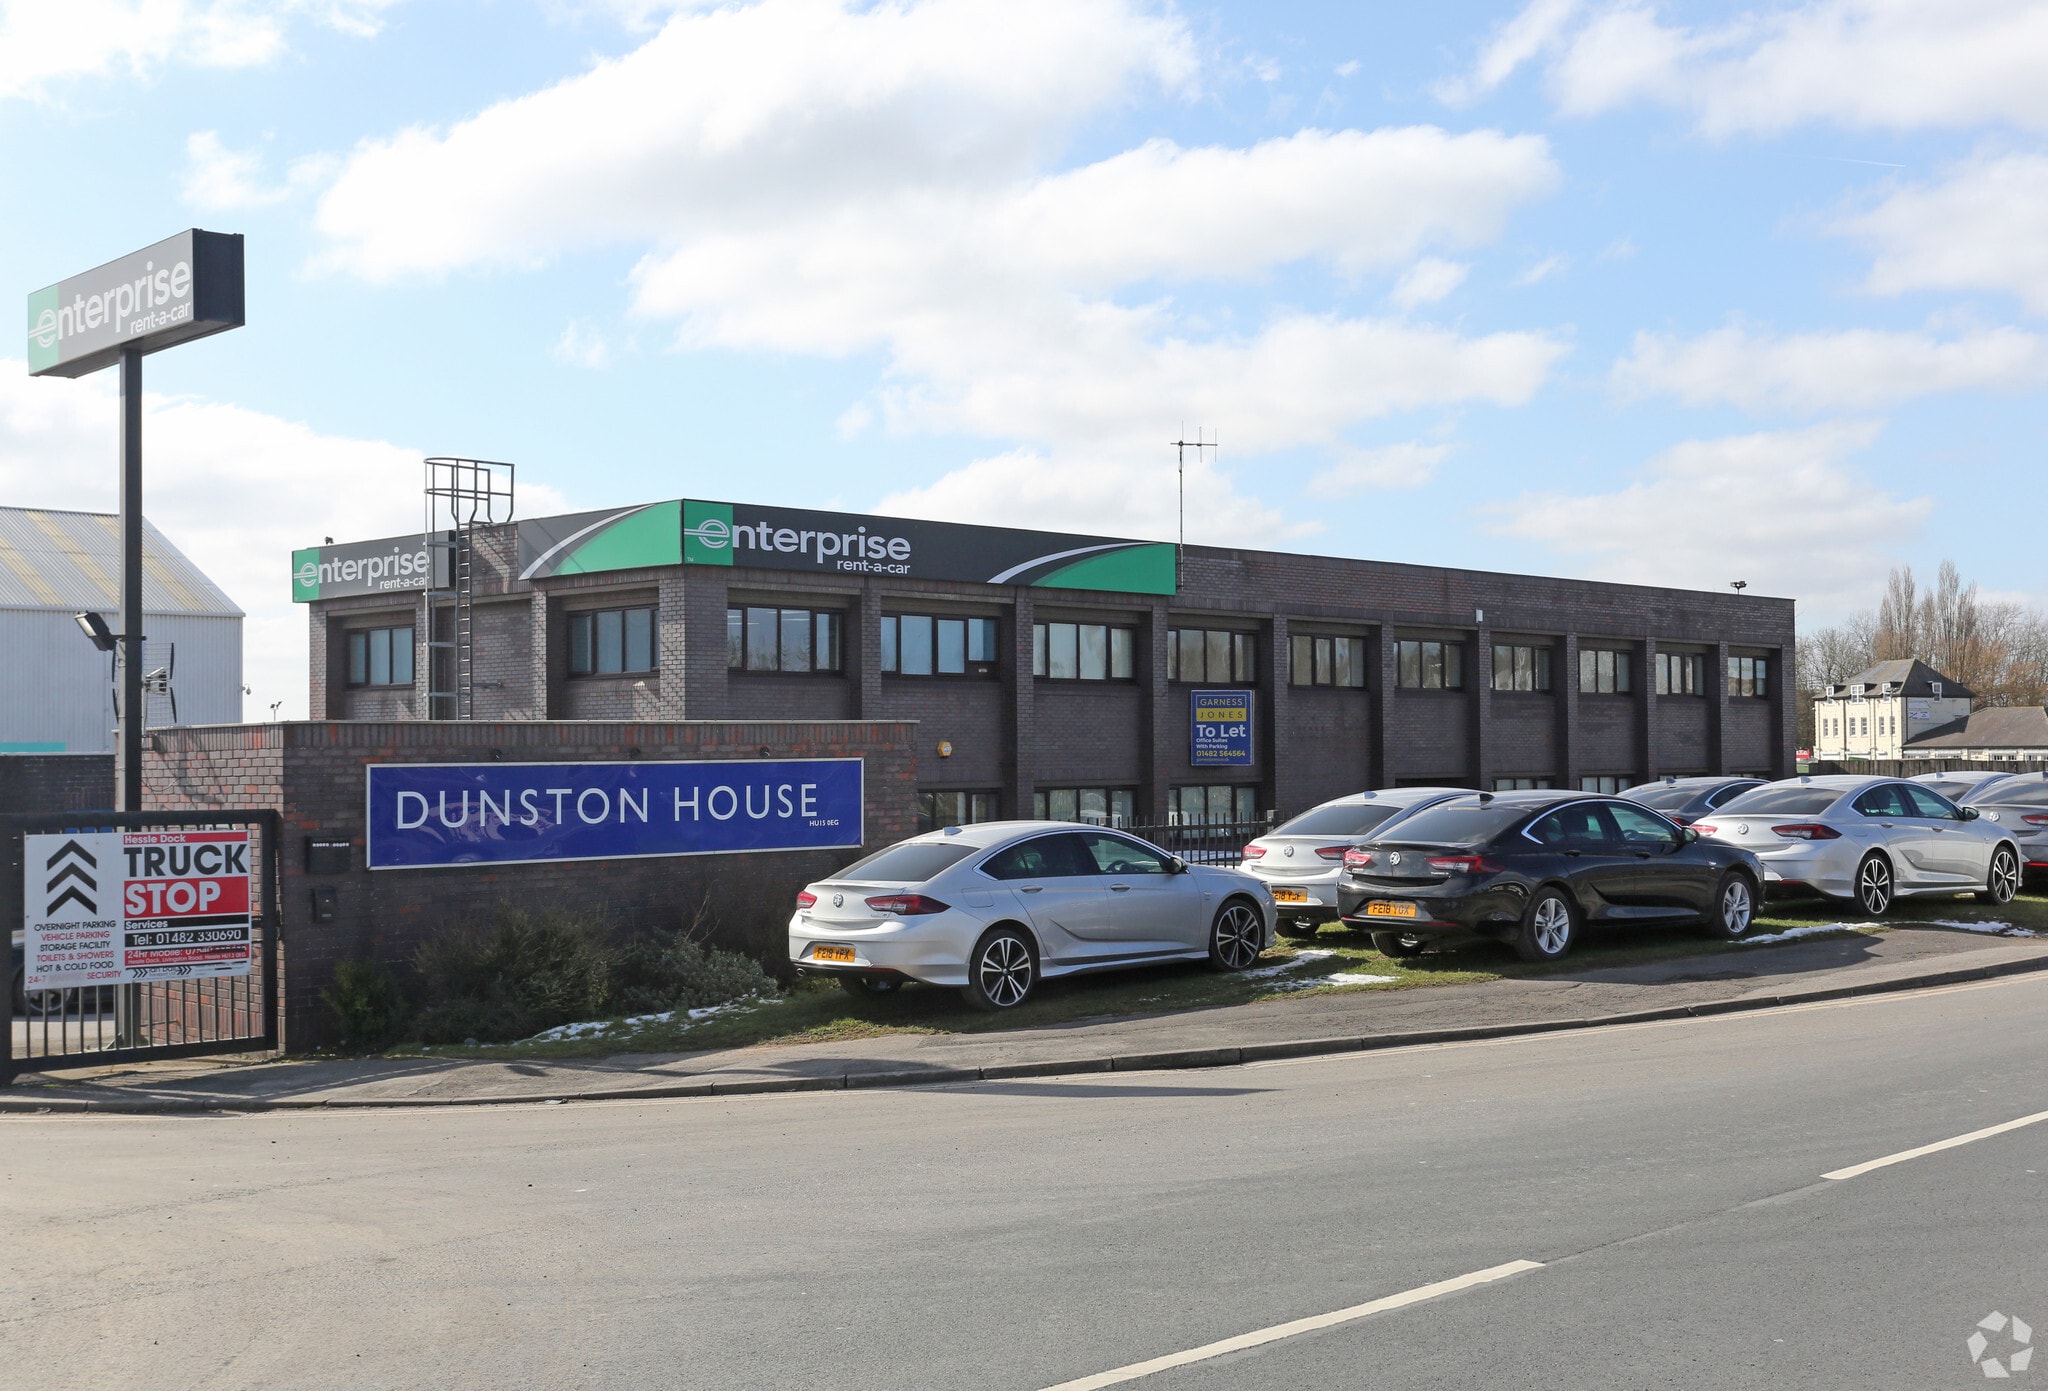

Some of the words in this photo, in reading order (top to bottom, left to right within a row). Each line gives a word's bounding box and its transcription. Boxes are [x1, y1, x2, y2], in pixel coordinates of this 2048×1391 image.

[29, 261, 190, 348] enterprise
[130, 300, 191, 335] rent-a-car
[684, 519, 911, 564] enterprise
[293, 546, 430, 587] enterprise
[837, 559, 911, 574] rent-a-car
[1200, 698, 1243, 706] GARNESS
[1200, 711, 1243, 719] JONES
[1196, 724, 1216, 737] To
[1220, 724, 1246, 737] Let
[397, 787, 649, 830] DUNSTON
[674, 783, 818, 822] HOUSE
[124, 835, 158, 844] Hessle
[160, 834, 186, 843] Dock
[124, 844, 247, 877] TRUCK
[125, 881, 221, 915] STOP
[1373, 903, 1391, 914] FE18
[34, 922, 80, 931] OVERNIGHT
[82, 920, 116, 929] PARKING
[125, 920, 168, 930] Services
[41, 933, 74, 941] VEHICLE
[76, 931, 110, 939] PARKING
[133, 934, 153, 946] Tel:
[156, 932, 194, 944] 01482
[197, 929, 241, 942] 330690
[40, 943, 77, 952] STORAGE
[79, 941, 111, 949] FACILITY
[37, 953, 66, 962] TOILETS
[68, 953, 74, 961] &
[76, 951, 114, 959] SHOWERS
[36, 964, 53, 973] HOT
[64, 962, 88, 971] COLD
[90, 961, 114, 969] FOOD
[86, 970, 122, 980] SECURITY
